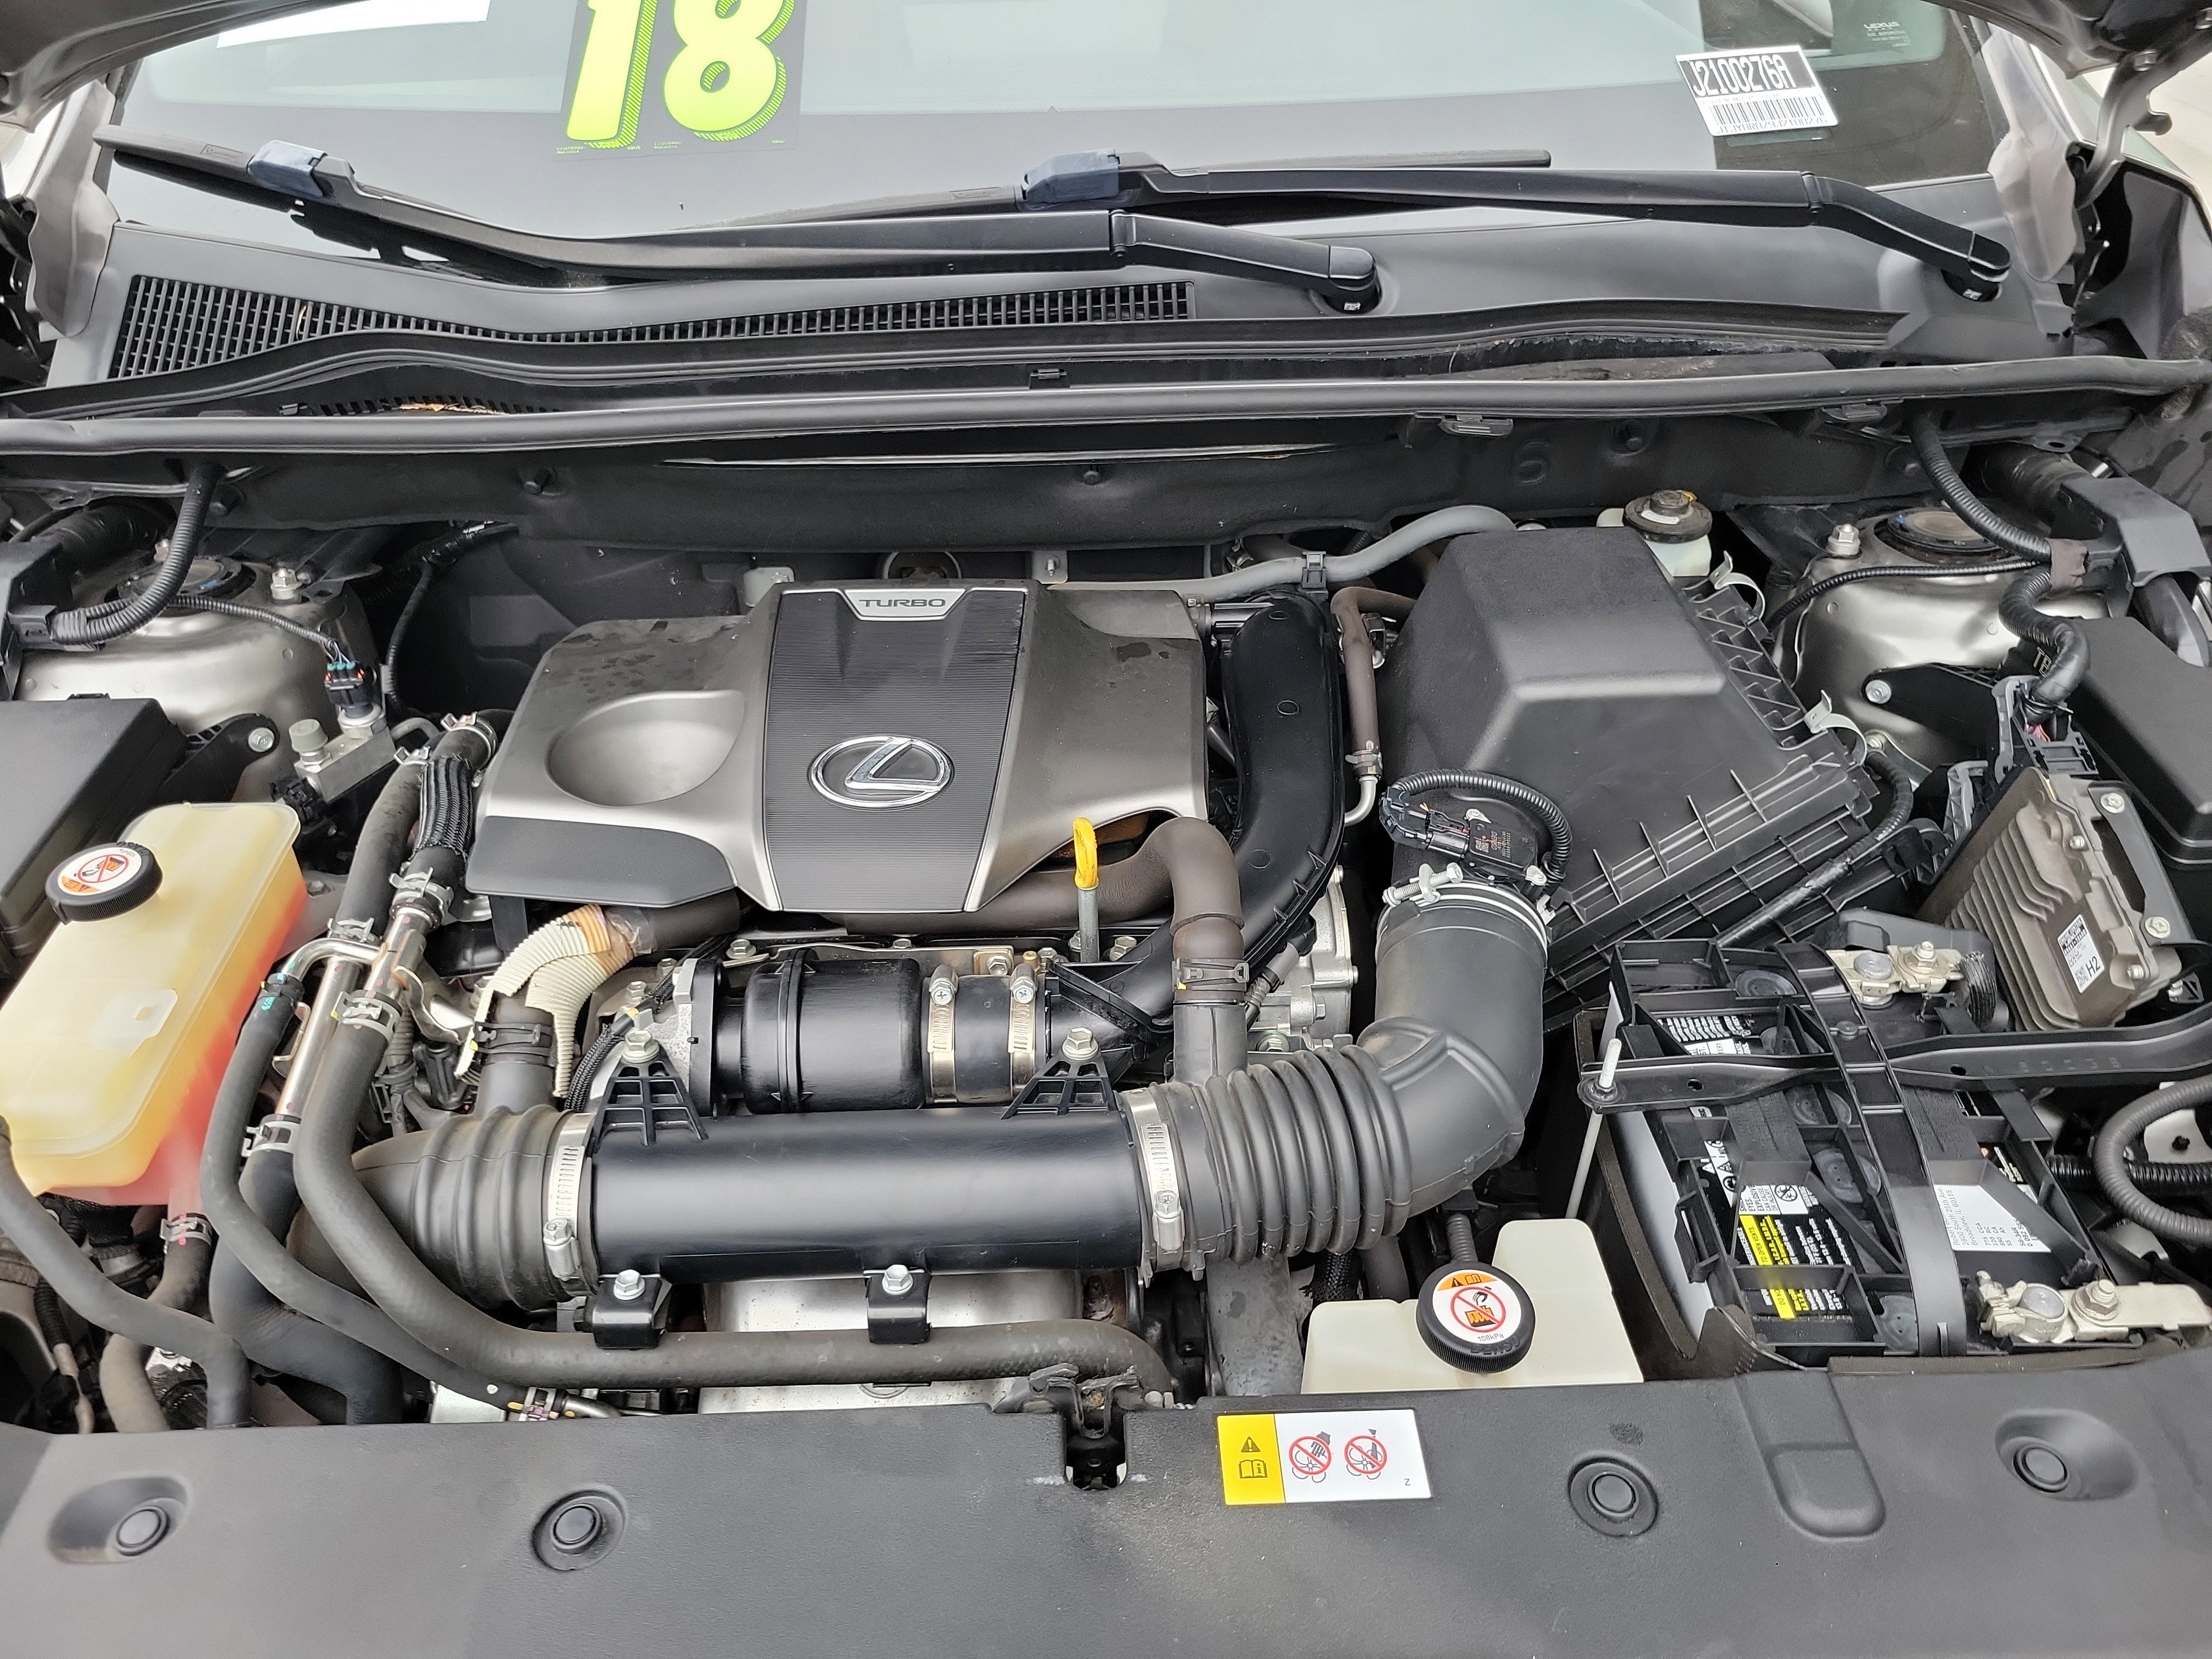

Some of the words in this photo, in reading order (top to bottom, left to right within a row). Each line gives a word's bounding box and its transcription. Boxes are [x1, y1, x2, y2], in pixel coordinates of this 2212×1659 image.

[1689, 54, 1797, 97] J2100276A
[859, 599, 946, 607] TURBO
[2085, 956, 2101, 978] H2
[1747, 1184, 1765, 1211] EXPLOSIVE
[1756, 1187, 1768, 1201] CAUSE
[1938, 1187, 1947, 1198] Ave.
[1946, 1190, 1959, 1207] 60155
[1743, 1197, 1756, 1211] EYES.
[1763, 1203, 1772, 1211] CAN
[1943, 1199, 1953, 1213] 25th
[1949, 1214, 1961, 1231] South
[1976, 1222, 1984, 1233] CCA
[1747, 1225, 1759, 1241] VENTS.
[1960, 1215, 1978, 1245] Broadview,
[2011, 1227, 2026, 1246] S6-34R
[2021, 1231, 2030, 1242] 092
[1959, 1231, 1969, 1245] 2800
[1982, 1236, 1991, 1245] 775
[1989, 1237, 1999, 1246] 120
[1997, 1237, 2006, 1246] 890
[1754, 1243, 1765, 1255] OPEN
[1477, 1333, 1504, 1342] 108kPa
[1470, 1335, 1521, 1356] DENSO
[1404, 1477, 1411, 1486] Z
